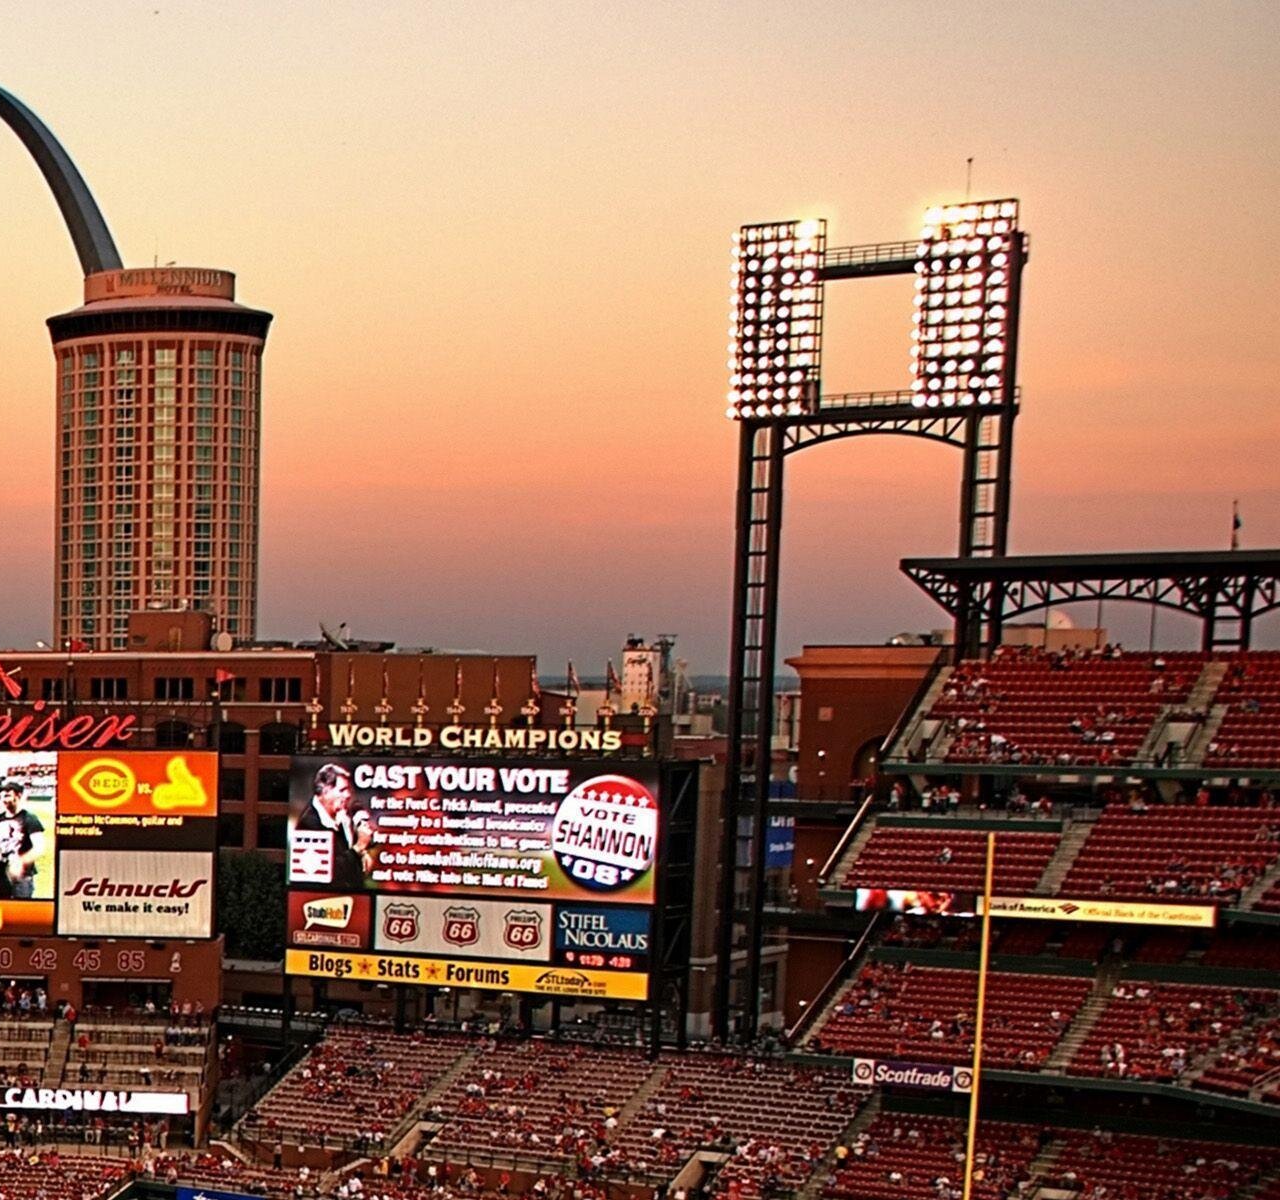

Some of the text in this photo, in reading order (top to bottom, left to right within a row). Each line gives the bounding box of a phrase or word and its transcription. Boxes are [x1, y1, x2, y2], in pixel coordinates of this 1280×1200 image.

[329, 723, 622, 751] WORLD CHAMPIONS
[354, 764, 570, 794] CAST YOUR VOTE
[580, 807, 636, 825] VOTE
[555, 820, 652, 861] SHANNON
[64, 877, 208, 898] Schnucks
[82, 901, 189, 916] We make it easy!
[1020, 904, 1055, 913] America
[390, 920, 413, 936] 66
[449, 923, 473, 939] 66
[559, 911, 608, 930] STIFEL
[510, 926, 534, 943] 66
[565, 929, 648, 950] NICOLAUS
[29, 948, 57, 970] 42
[73, 949, 101, 971] 45
[117, 951, 145, 972] 85
[309, 954, 510, 985] Blogs Stats Forums
[875, 1065, 951, 1087] Scottrade
